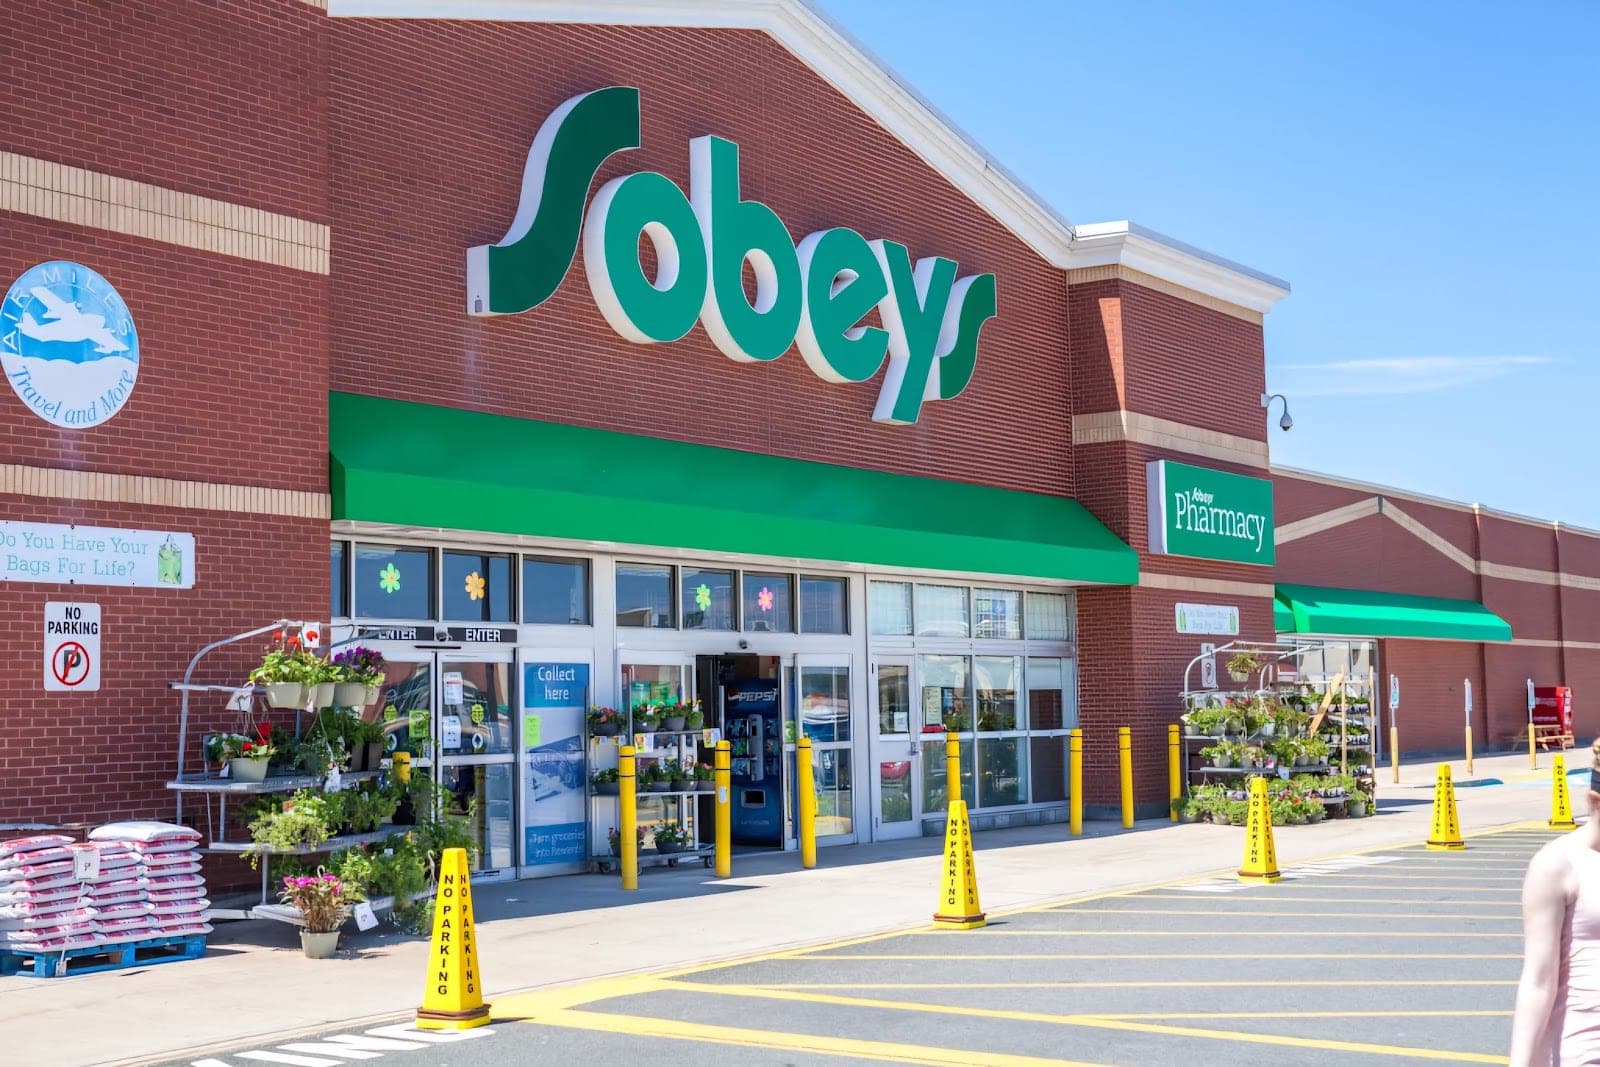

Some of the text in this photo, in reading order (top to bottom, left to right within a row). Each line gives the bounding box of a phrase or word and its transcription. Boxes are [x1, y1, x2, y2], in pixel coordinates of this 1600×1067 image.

[466, 85, 997, 424] Sobeys
[3, 266, 132, 350] AIR MILES
[9, 365, 134, 424] Travel and More
[1174, 491, 1266, 553] Pharmacy
[23, 532, 54, 549] You
[62, 534, 105, 552] Have
[111, 537, 149, 555] Your
[7, 555, 135, 577] Bags For Life?
[65, 606, 81, 620] NO
[48, 621, 99, 636] PARKING
[465, 629, 501, 642] ENTER
[538, 664, 575, 681] Collect
[544, 684, 569, 700] here
[1252, 793, 1259, 807] NO
[948, 819, 958, 905] NO PARKING
[438, 874, 454, 995] NO PARKING
[460, 874, 474, 994] NO PARKING
